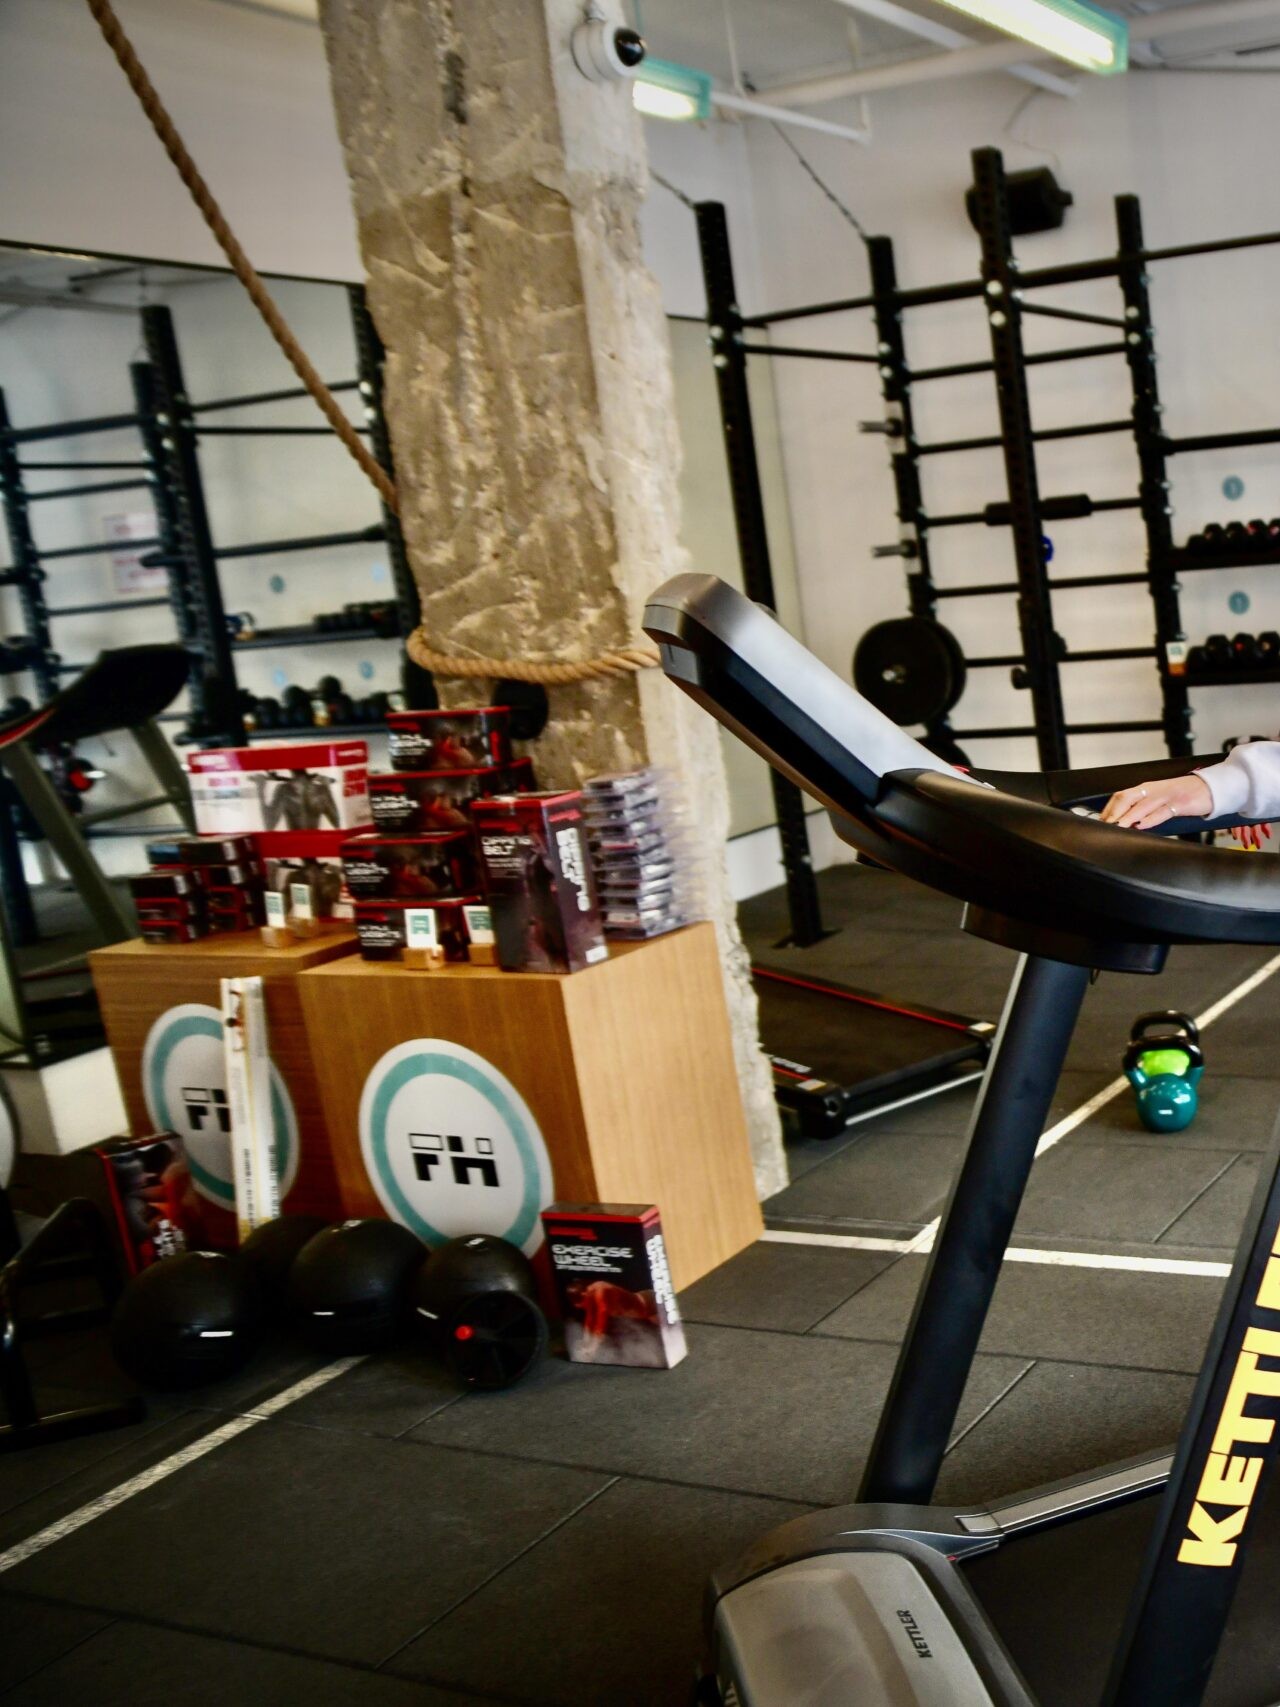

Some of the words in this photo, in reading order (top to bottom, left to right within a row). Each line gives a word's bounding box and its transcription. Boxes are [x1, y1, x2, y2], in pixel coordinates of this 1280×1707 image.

[552, 1243, 633, 1258] EXERCISE
[554, 1254, 612, 1267] WHEEL
[896, 1609, 933, 1658] KETTLER
